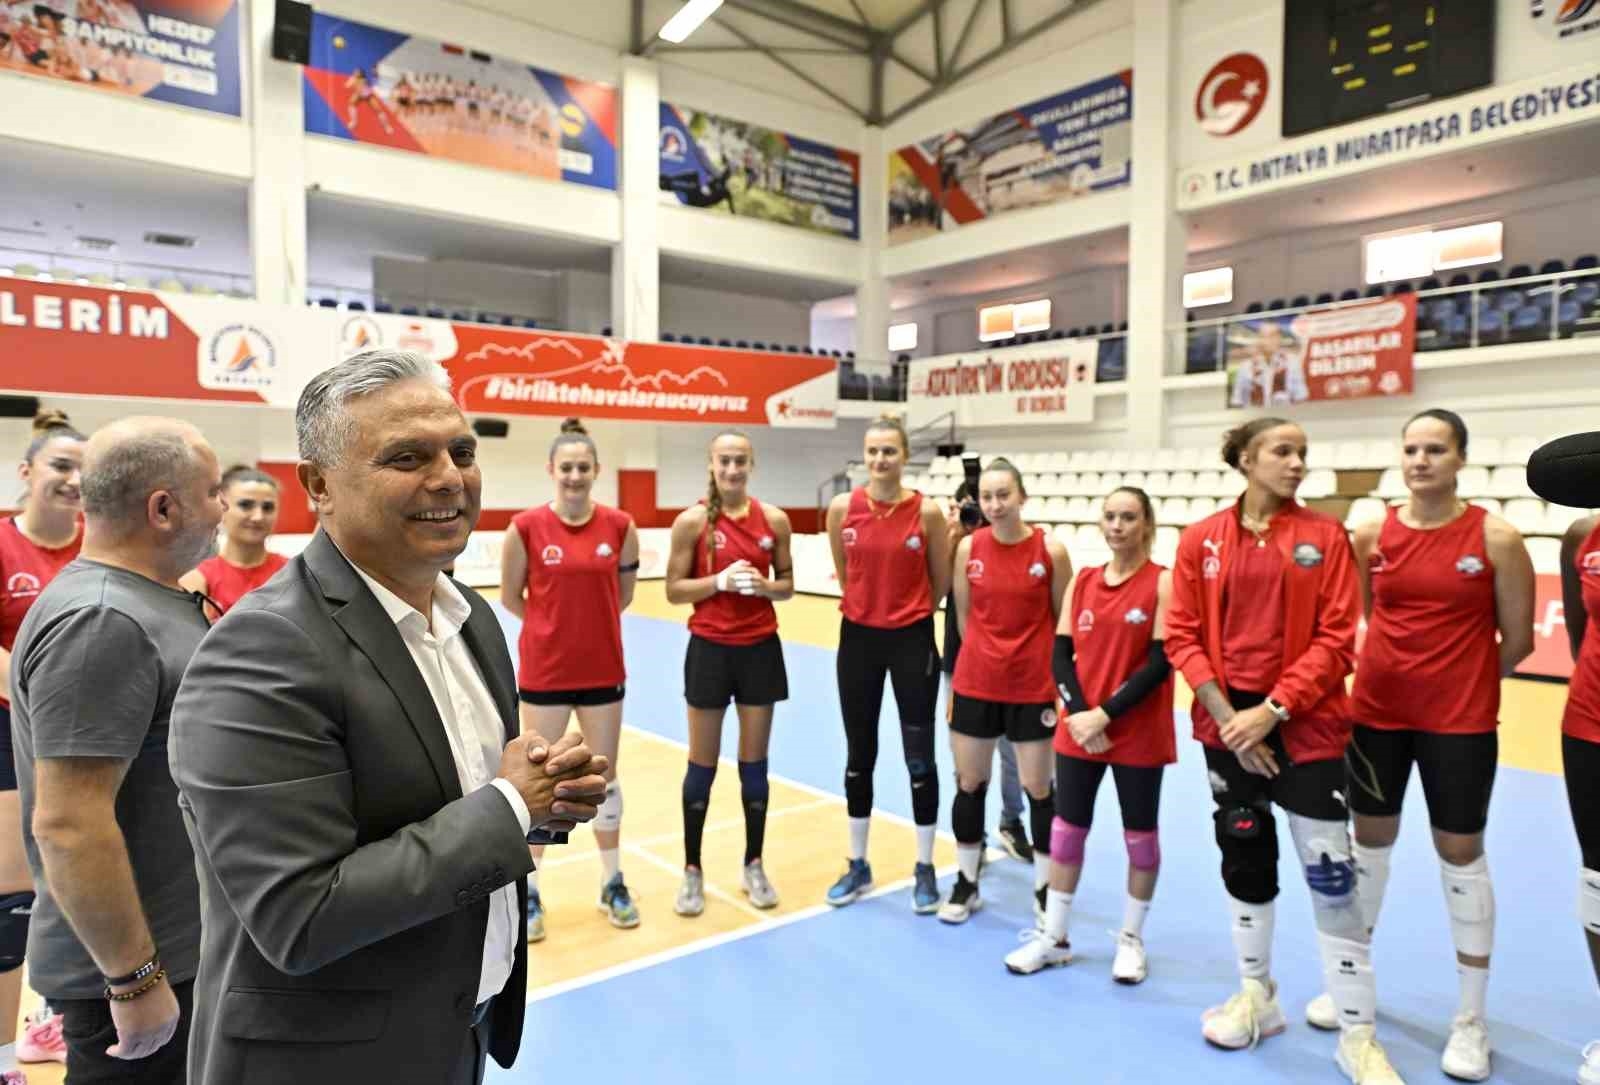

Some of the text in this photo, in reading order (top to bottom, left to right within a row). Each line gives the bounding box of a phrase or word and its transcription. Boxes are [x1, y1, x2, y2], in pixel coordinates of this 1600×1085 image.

[148, 14, 216, 44] HEDEF
[1089, 102, 1128, 124] SPOR
[1214, 169, 1242, 192] T.C.
[1249, 146, 1328, 184] ANTALYA
[0, 291, 169, 339] LERİM
[1008, 358, 1069, 391] ORDUSU
